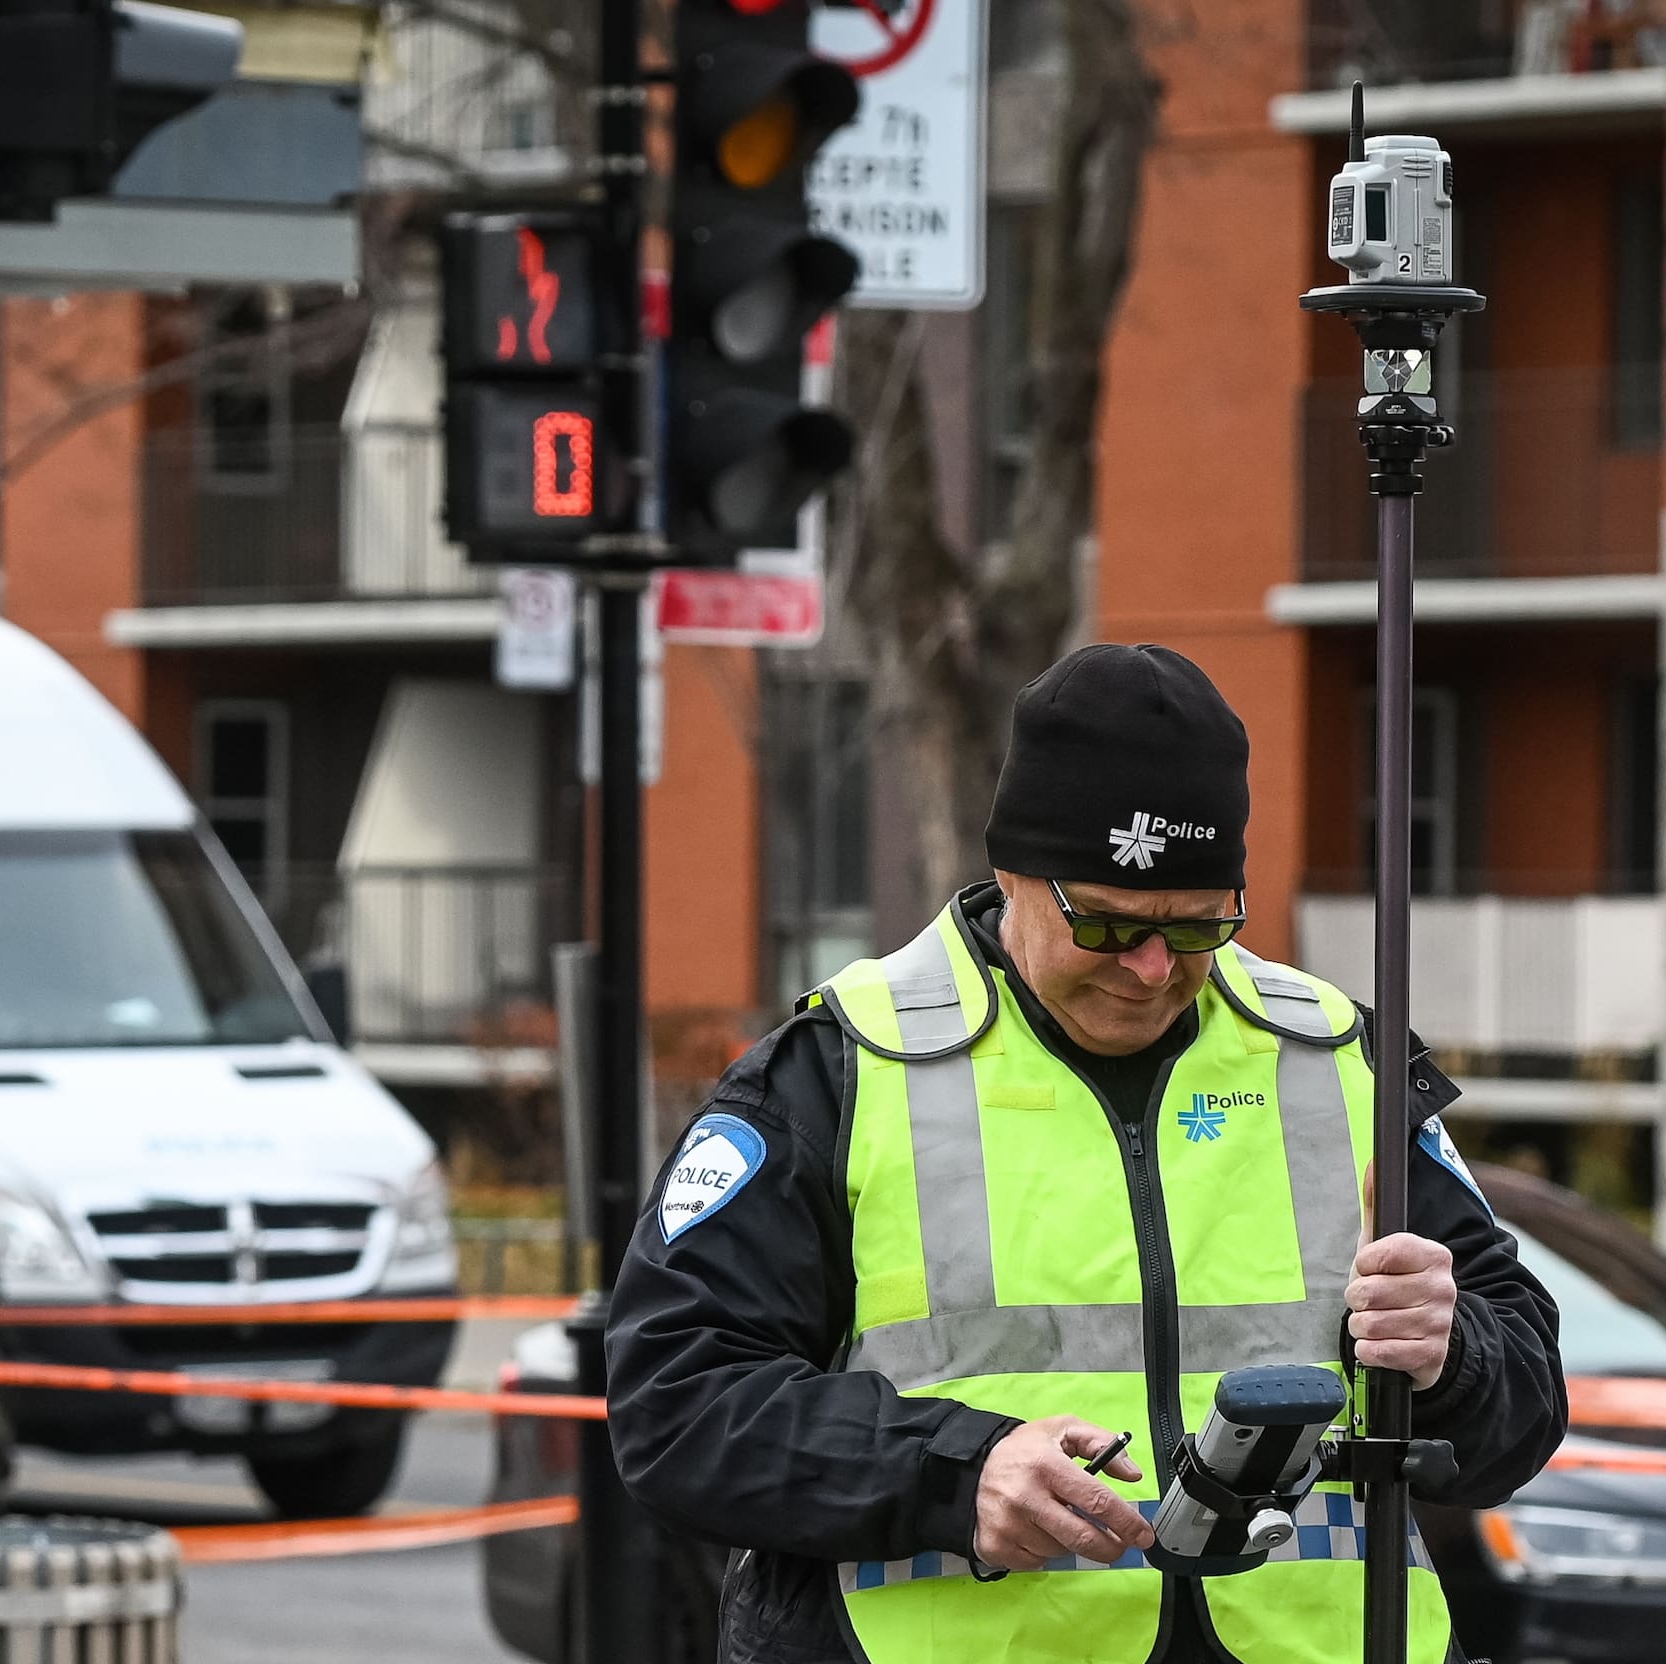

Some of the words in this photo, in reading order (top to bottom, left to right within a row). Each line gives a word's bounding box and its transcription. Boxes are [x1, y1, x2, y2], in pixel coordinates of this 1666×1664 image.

[1399, 255, 1411, 272] 2
[534, 411, 593, 516] 0
[1151, 817, 1216, 840] Police
[1206, 1091, 1265, 1110] Police
[671, 1166, 732, 1190] POLICE
